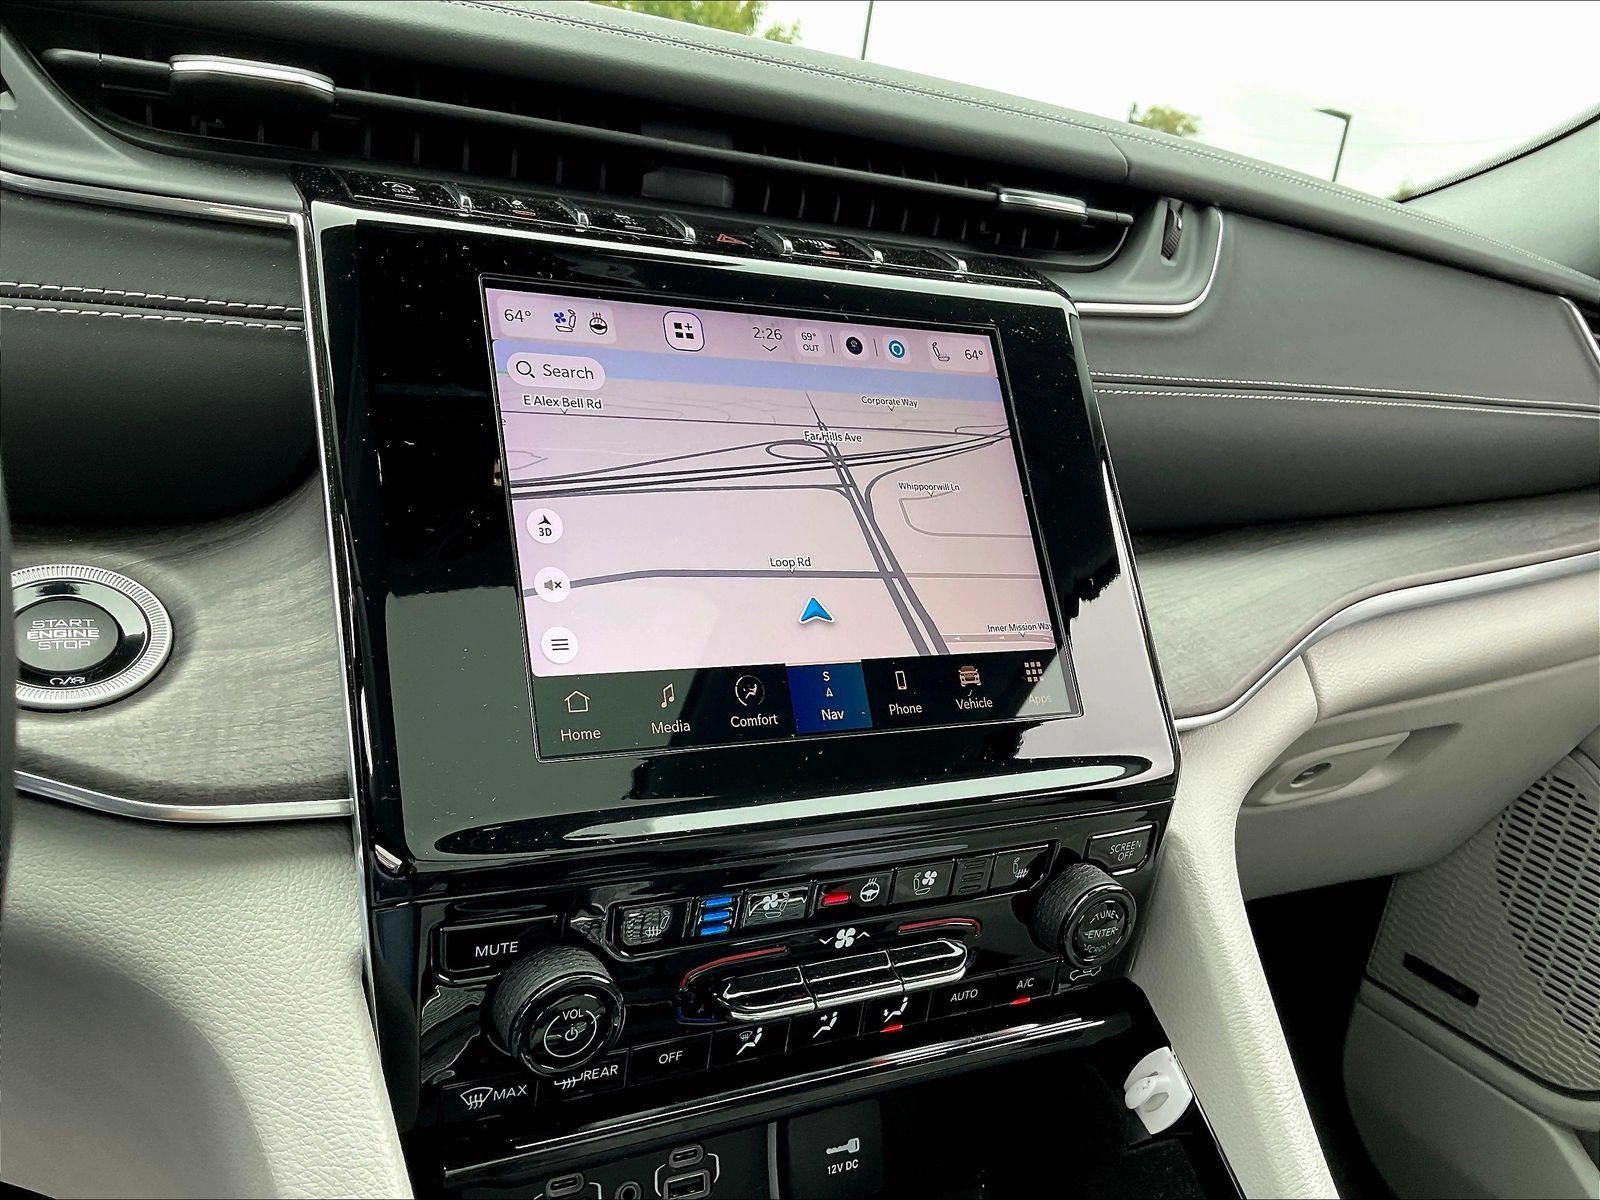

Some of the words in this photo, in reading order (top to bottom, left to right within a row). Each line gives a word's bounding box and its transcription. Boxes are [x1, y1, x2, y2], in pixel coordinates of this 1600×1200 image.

[504, 308, 532, 323] 64°
[753, 327, 783, 341] 2:26
[801, 331, 817, 341] 69°
[803, 343, 819, 353] OUT
[964, 349, 984, 361] 64°
[542, 363, 594, 381] Search
[523, 395, 532, 406] E
[533, 395, 560, 408] Alex
[562, 397, 584, 409] Bell
[586, 398, 602, 410] Rd
[861, 396, 901, 408] Corporate
[901, 398, 918, 408] Way
[804, 431, 819, 442] Far
[821, 431, 843, 443] Hills
[844, 433, 862, 443] Ave
[898, 482, 950, 493] Whippoorwill
[950, 482, 960, 491] Ln
[538, 527, 552, 537] 3D
[770, 556, 795, 570] Loop
[797, 556, 811, 568] Rd
[32, 618, 95, 629] START
[987, 623, 1008, 633] Inner
[1008, 623, 1037, 632] Mission
[27, 629, 100, 640] ENGINE
[38, 640, 91, 651] STOP
[889, 702, 923, 716] Phone
[955, 696, 993, 711] Vehicle
[730, 712, 779, 728] Comfort
[821, 708, 844, 722] Nav
[560, 727, 601, 742] Home
[651, 720, 691, 735] Media
[1109, 840, 1142, 854] SCREEN
[1117, 850, 1134, 861] OFF
[1095, 909, 1116, 920] TUNE
[475, 941, 519, 958] MUTE
[1016, 977, 1035, 990] A/C
[950, 989, 979, 1002] AUTO
[562, 1009, 584, 1021] VOL
[658, 1051, 684, 1065] OFF
[583, 1065, 619, 1081] REAR
[493, 1085, 528, 1101] MAX
[827, 1163, 844, 1175] 12V
[845, 1159, 859, 1171] DC
